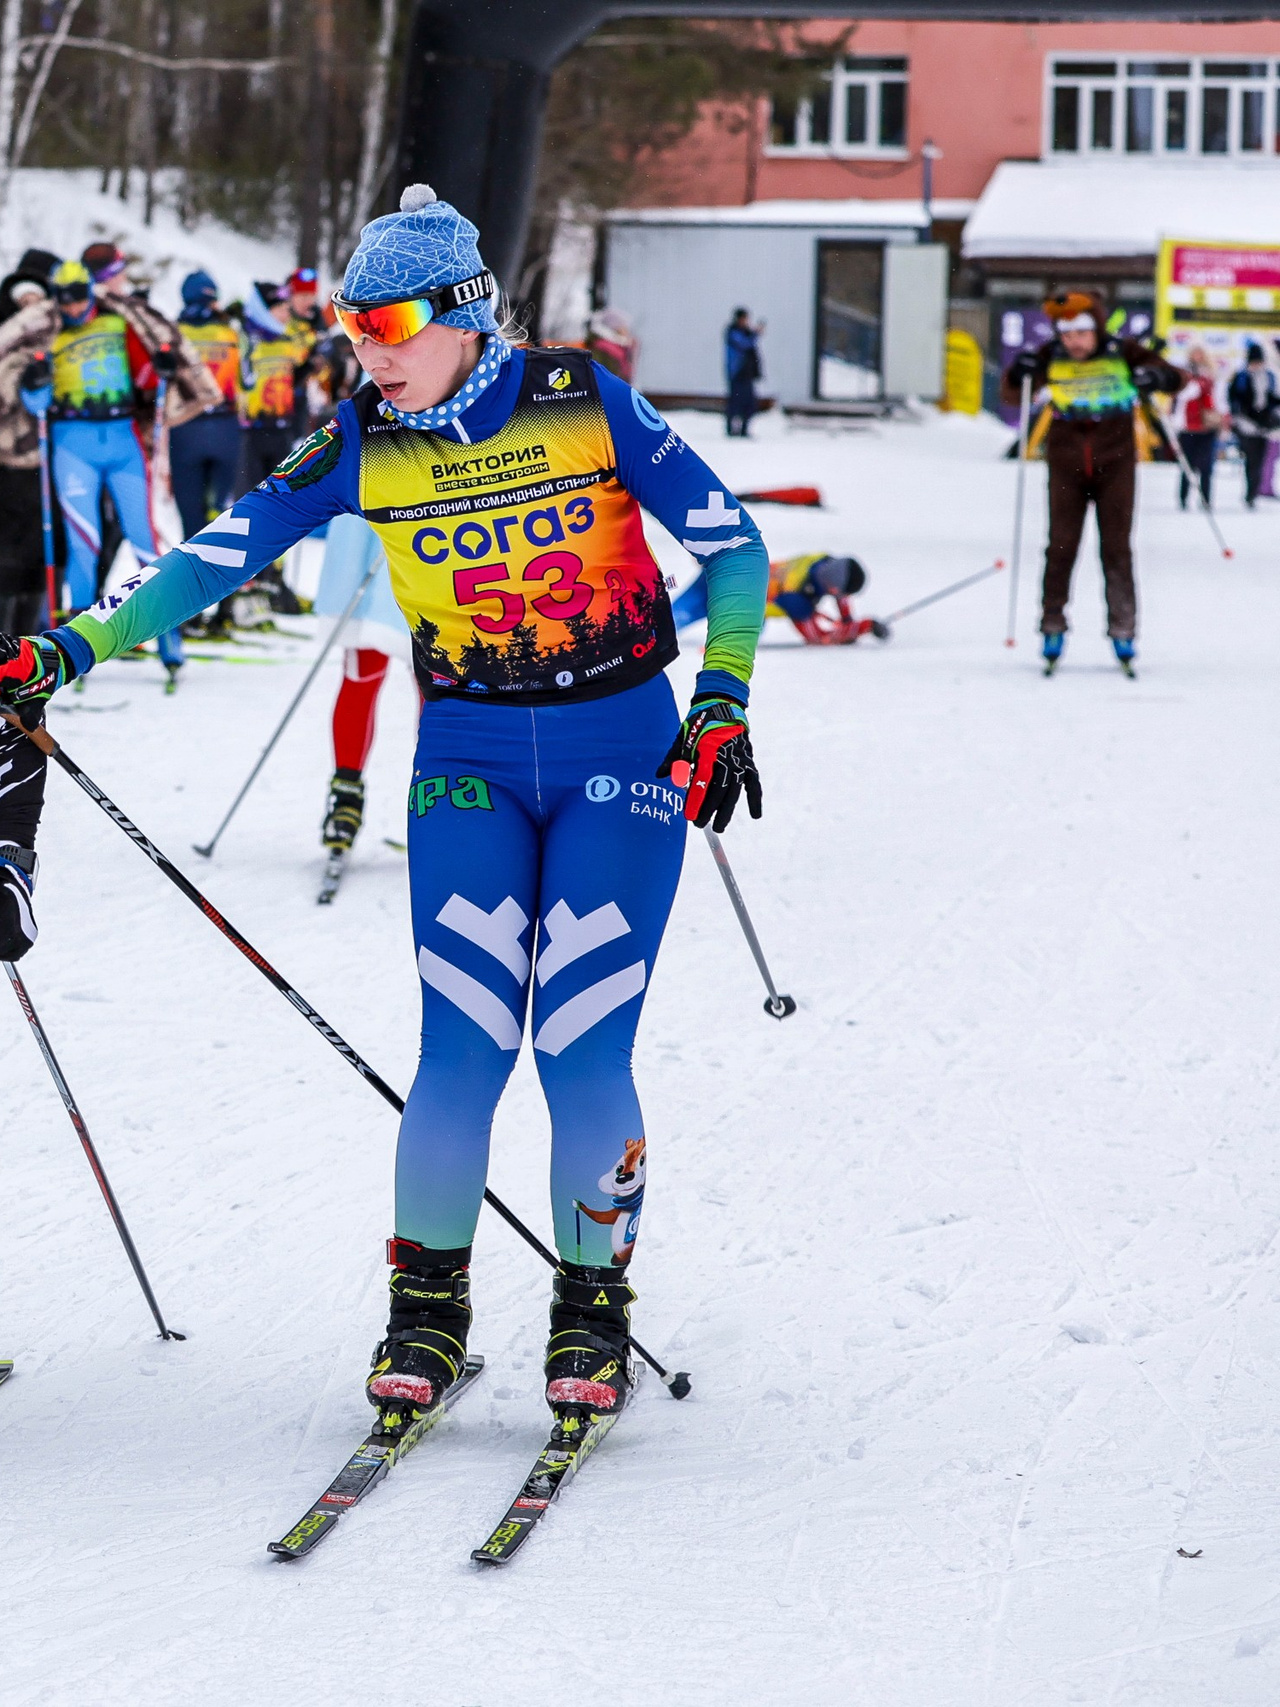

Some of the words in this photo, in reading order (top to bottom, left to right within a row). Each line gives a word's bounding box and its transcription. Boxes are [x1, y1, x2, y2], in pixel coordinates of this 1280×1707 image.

[431, 445, 547, 479] ВИКТОРИЯ
[436, 477, 479, 492] вместе
[481, 474, 499, 483] мы
[502, 463, 549, 480] строим
[390, 500, 472, 520] НОВОГОДНИЙ
[474, 482, 554, 508] КОМАНДНЫЙ
[453, 551, 594, 634] 53
[585, 656, 624, 677] DIWARI
[631, 801, 672, 826] БАНК
[403, 1288, 452, 1299] FISCHER
